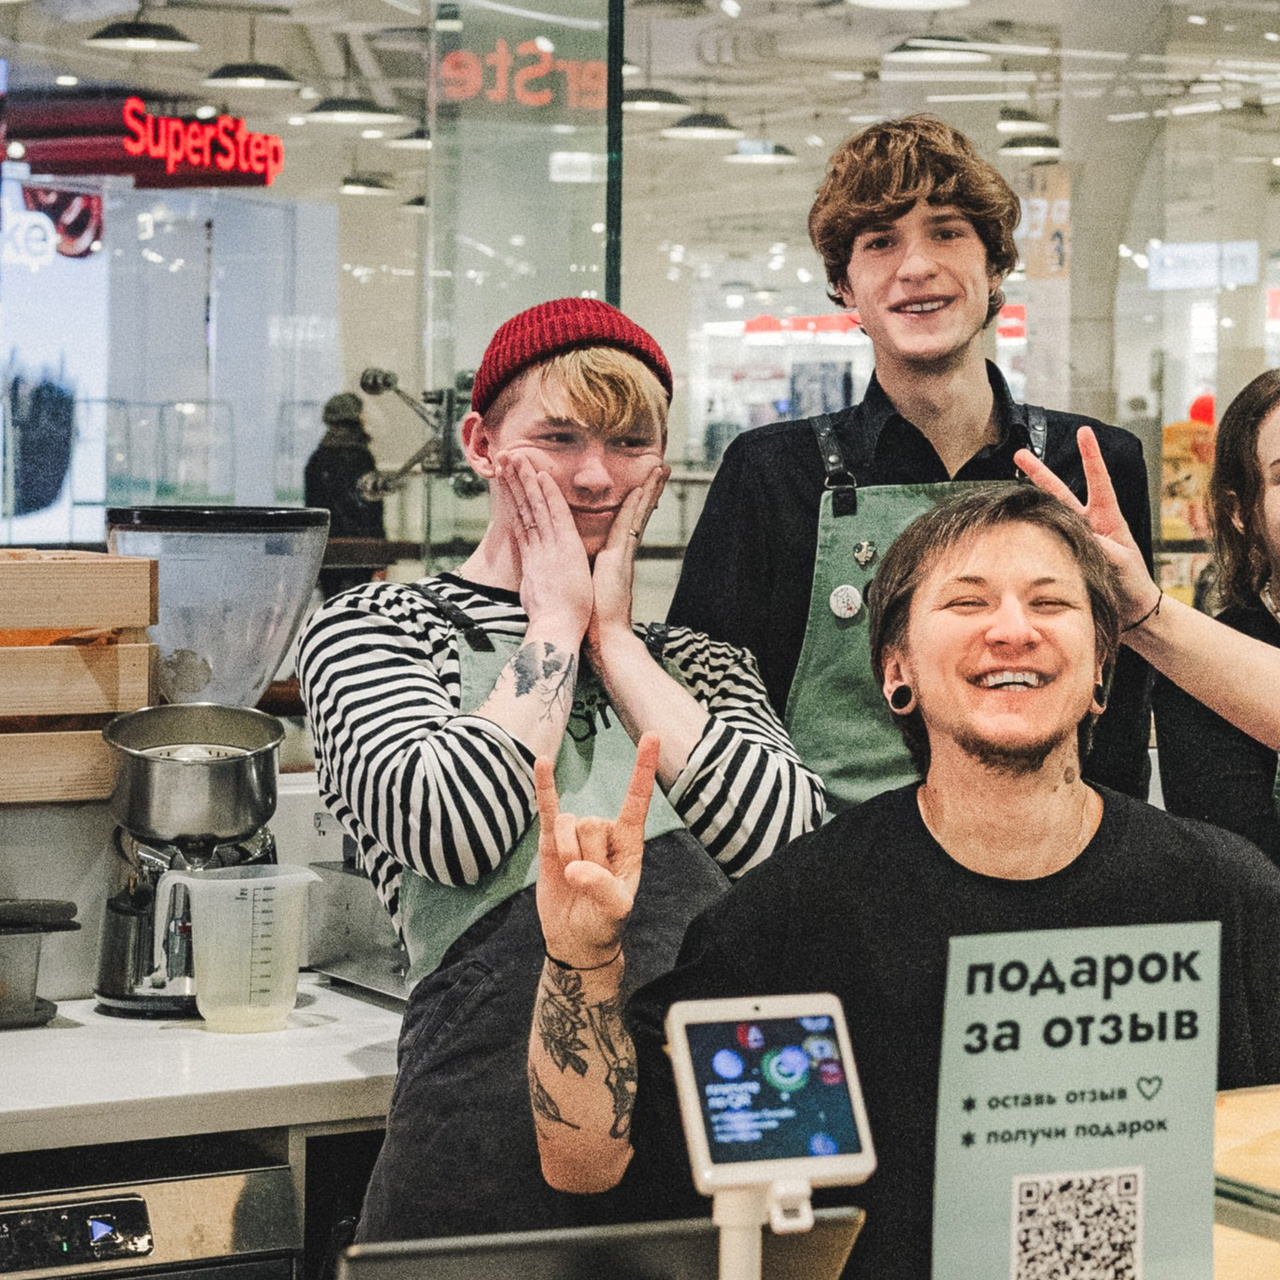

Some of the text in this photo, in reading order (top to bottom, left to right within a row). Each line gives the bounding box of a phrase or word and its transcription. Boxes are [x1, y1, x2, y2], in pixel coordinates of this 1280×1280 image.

[122, 96, 285, 186] SuperStep
[965, 949, 1202, 1000] подарок
[963, 1009, 1200, 1056] за отзыв
[986, 1085, 1128, 1111] оставь отзыв
[985, 1118, 1168, 1148] получи подарок
